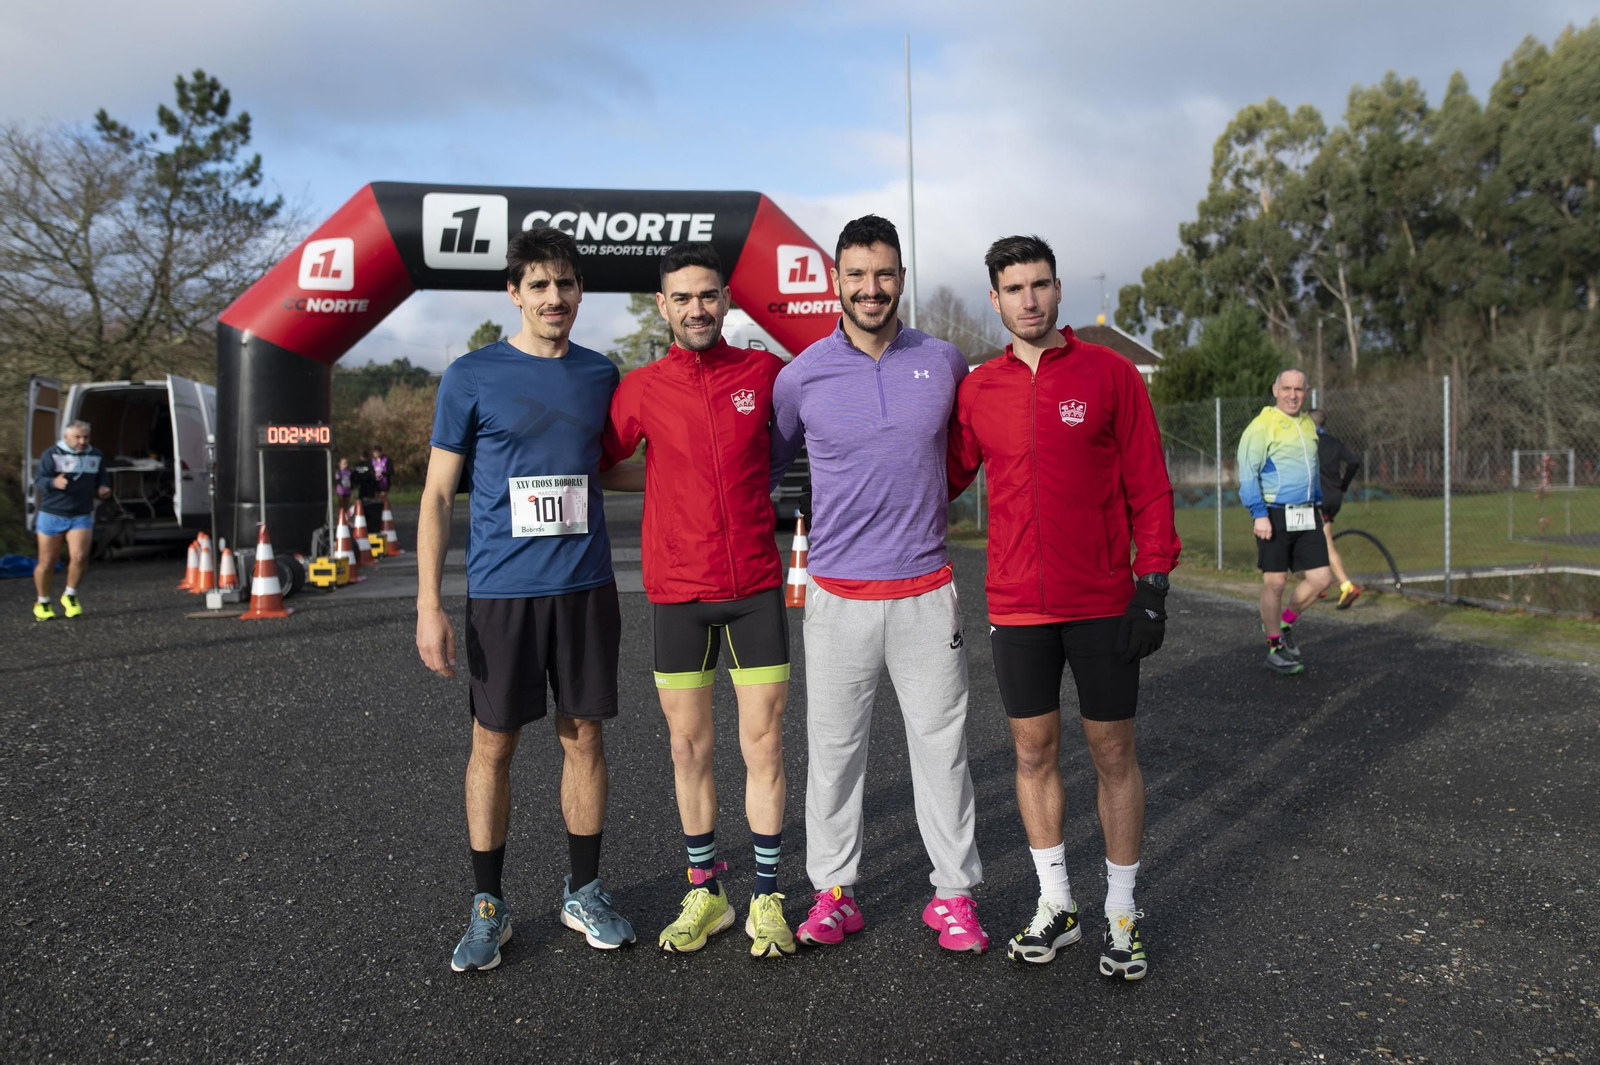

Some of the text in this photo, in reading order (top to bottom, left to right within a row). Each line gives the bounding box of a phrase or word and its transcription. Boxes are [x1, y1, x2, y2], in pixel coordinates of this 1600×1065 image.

[521, 209, 716, 242] CCNORTE
[598, 244, 645, 257] SPORTS
[645, 245, 673, 257] EVE
[282, 297, 370, 313] CCNORTE
[768, 300, 843, 314] CCNORTE
[516, 477, 583, 489] XXV CROSS BOBORÁS
[534, 496, 563, 522] 101
[1295, 513, 1304, 525] 71
